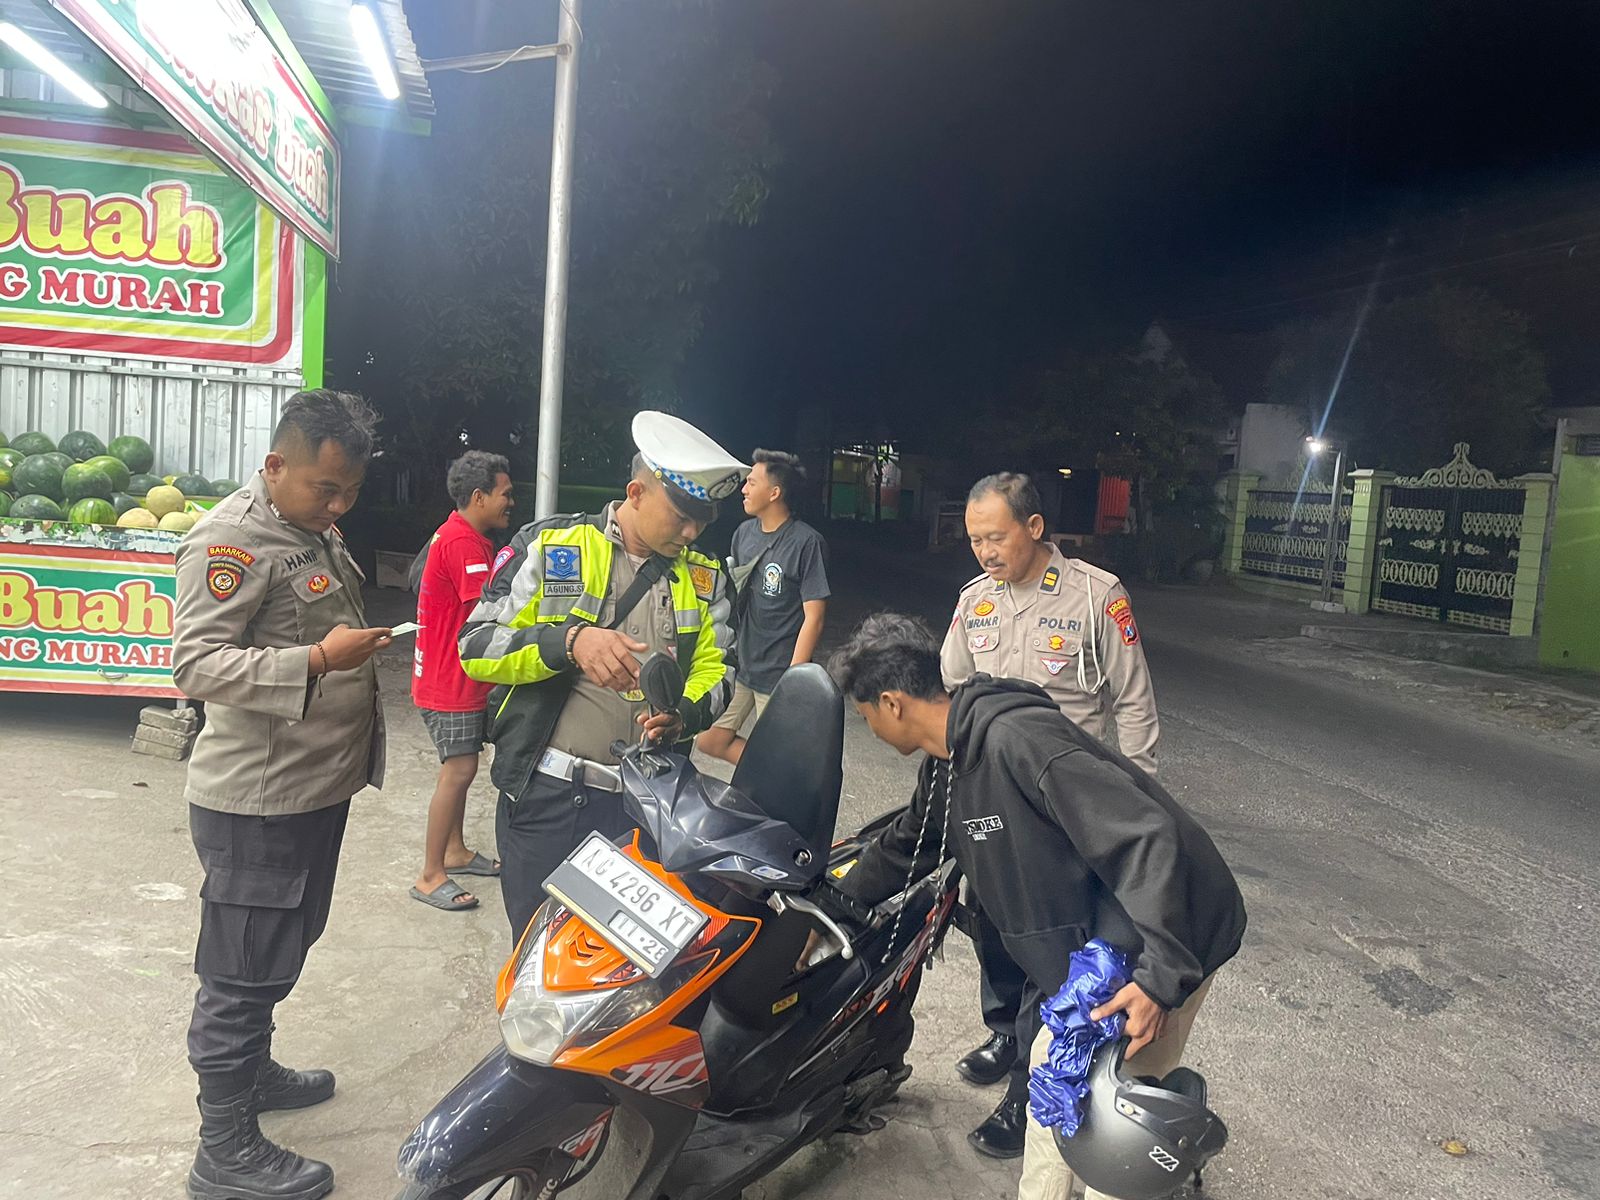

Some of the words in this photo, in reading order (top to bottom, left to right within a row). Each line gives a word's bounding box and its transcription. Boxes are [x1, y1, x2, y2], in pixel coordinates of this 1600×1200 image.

[41, 268, 221, 315] MURAH
[209, 546, 253, 564] BAHARKAM
[0, 571, 174, 636] Buah
[1038, 616, 1082, 632] POLRI
[47, 640, 173, 667] MURAH
[581, 848, 616, 877] AG
[609, 871, 661, 912] 4296
[658, 905, 695, 940] XT
